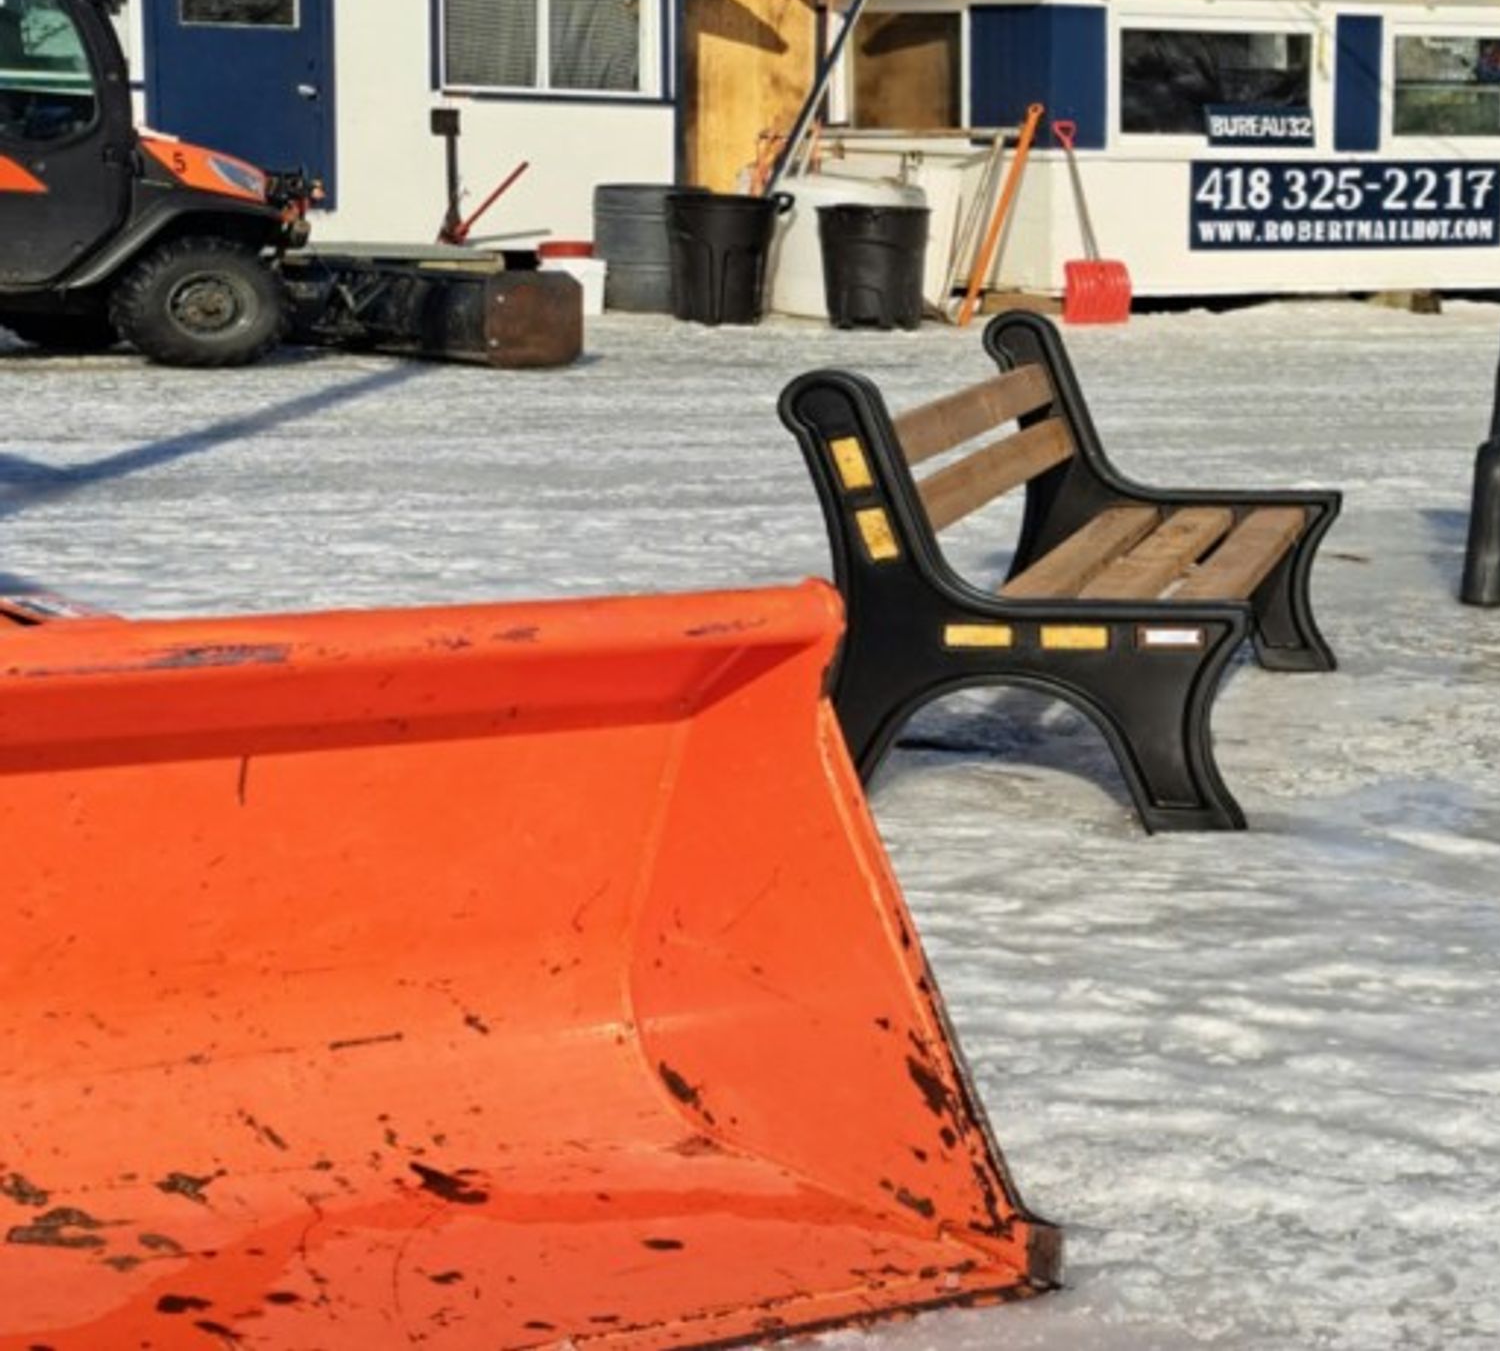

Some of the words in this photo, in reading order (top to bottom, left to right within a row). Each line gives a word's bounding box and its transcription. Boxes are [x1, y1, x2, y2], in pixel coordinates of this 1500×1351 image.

[173, 152, 187, 174] 5
[1196, 167, 1273, 210] 418
[1282, 168, 1496, 210] 325-2217
[1198, 219, 1493, 242] WWW.ROBERTMAILHOT.COM
